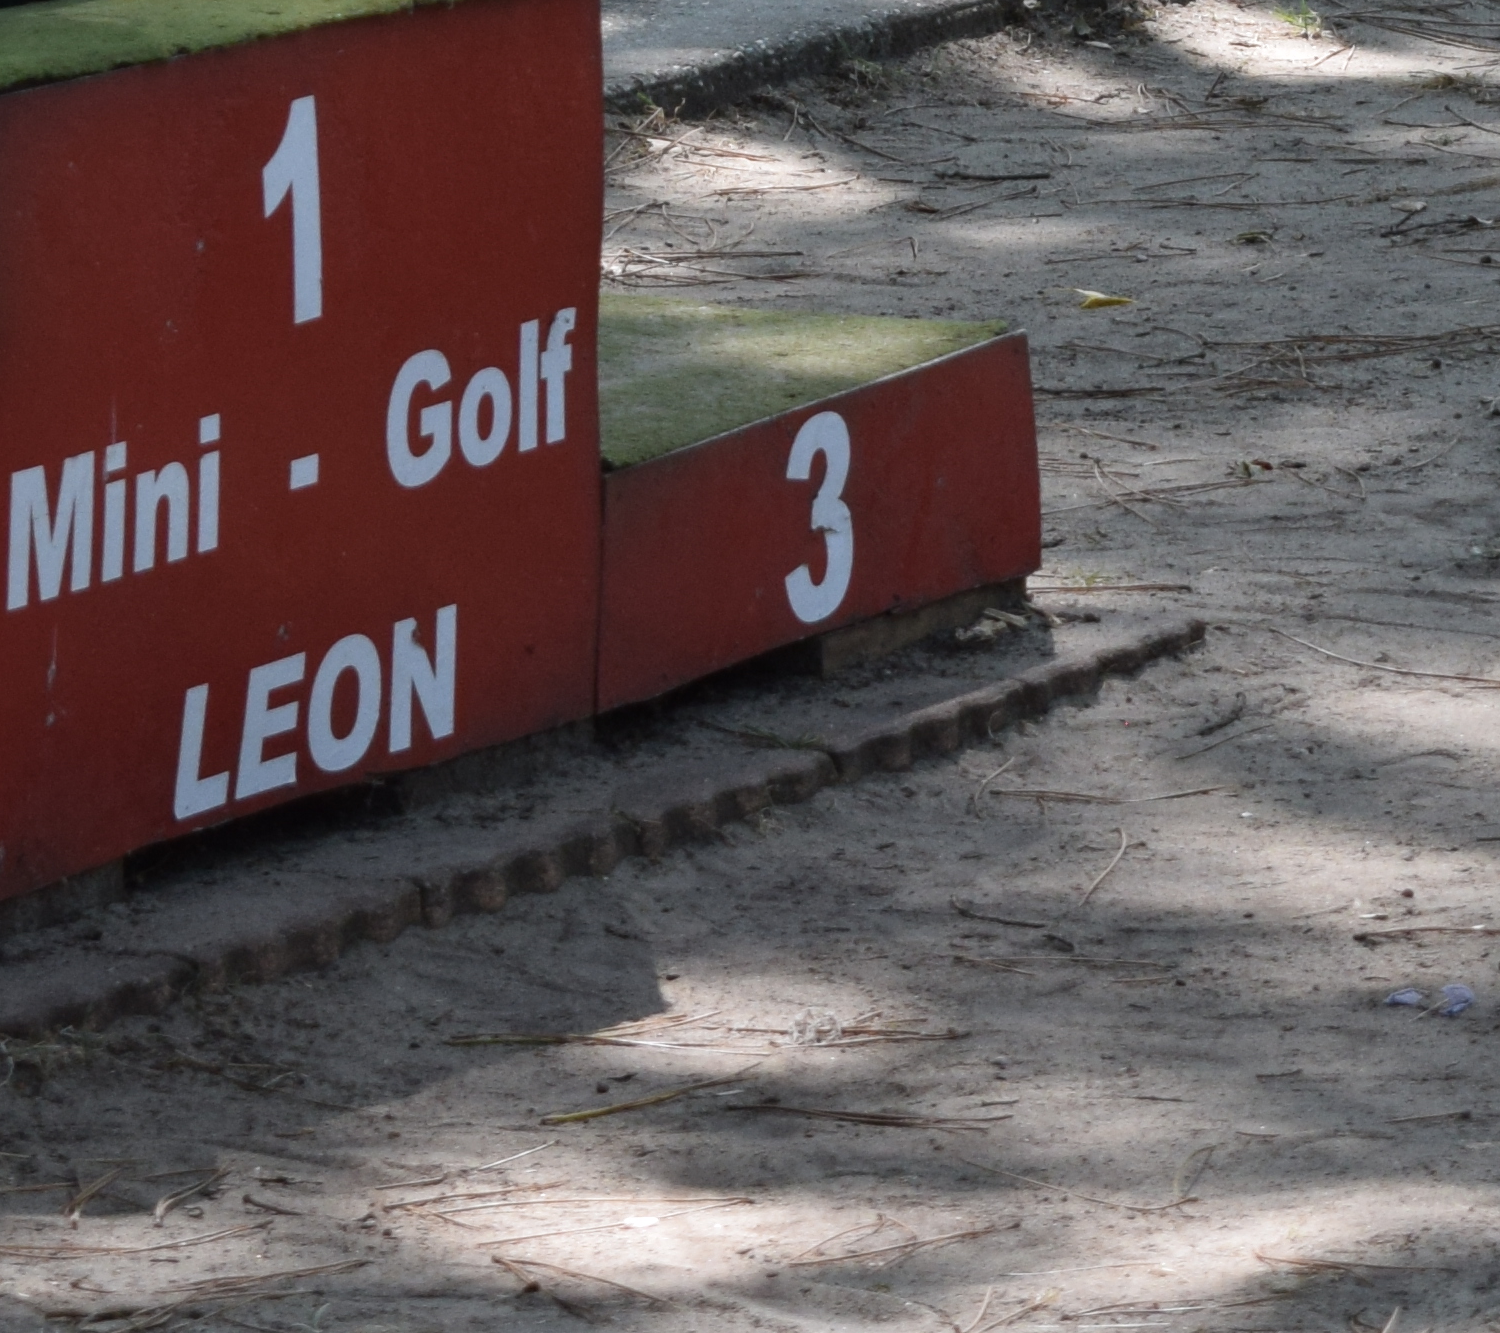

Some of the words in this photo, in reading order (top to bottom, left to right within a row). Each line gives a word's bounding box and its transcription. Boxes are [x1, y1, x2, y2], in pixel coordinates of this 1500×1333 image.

[262, 94, 323, 324] 1
[6, 413, 221, 611] Mini
[386, 306, 577, 488] Golf
[784, 410, 854, 623] 3
[173, 603, 457, 820] LEON
